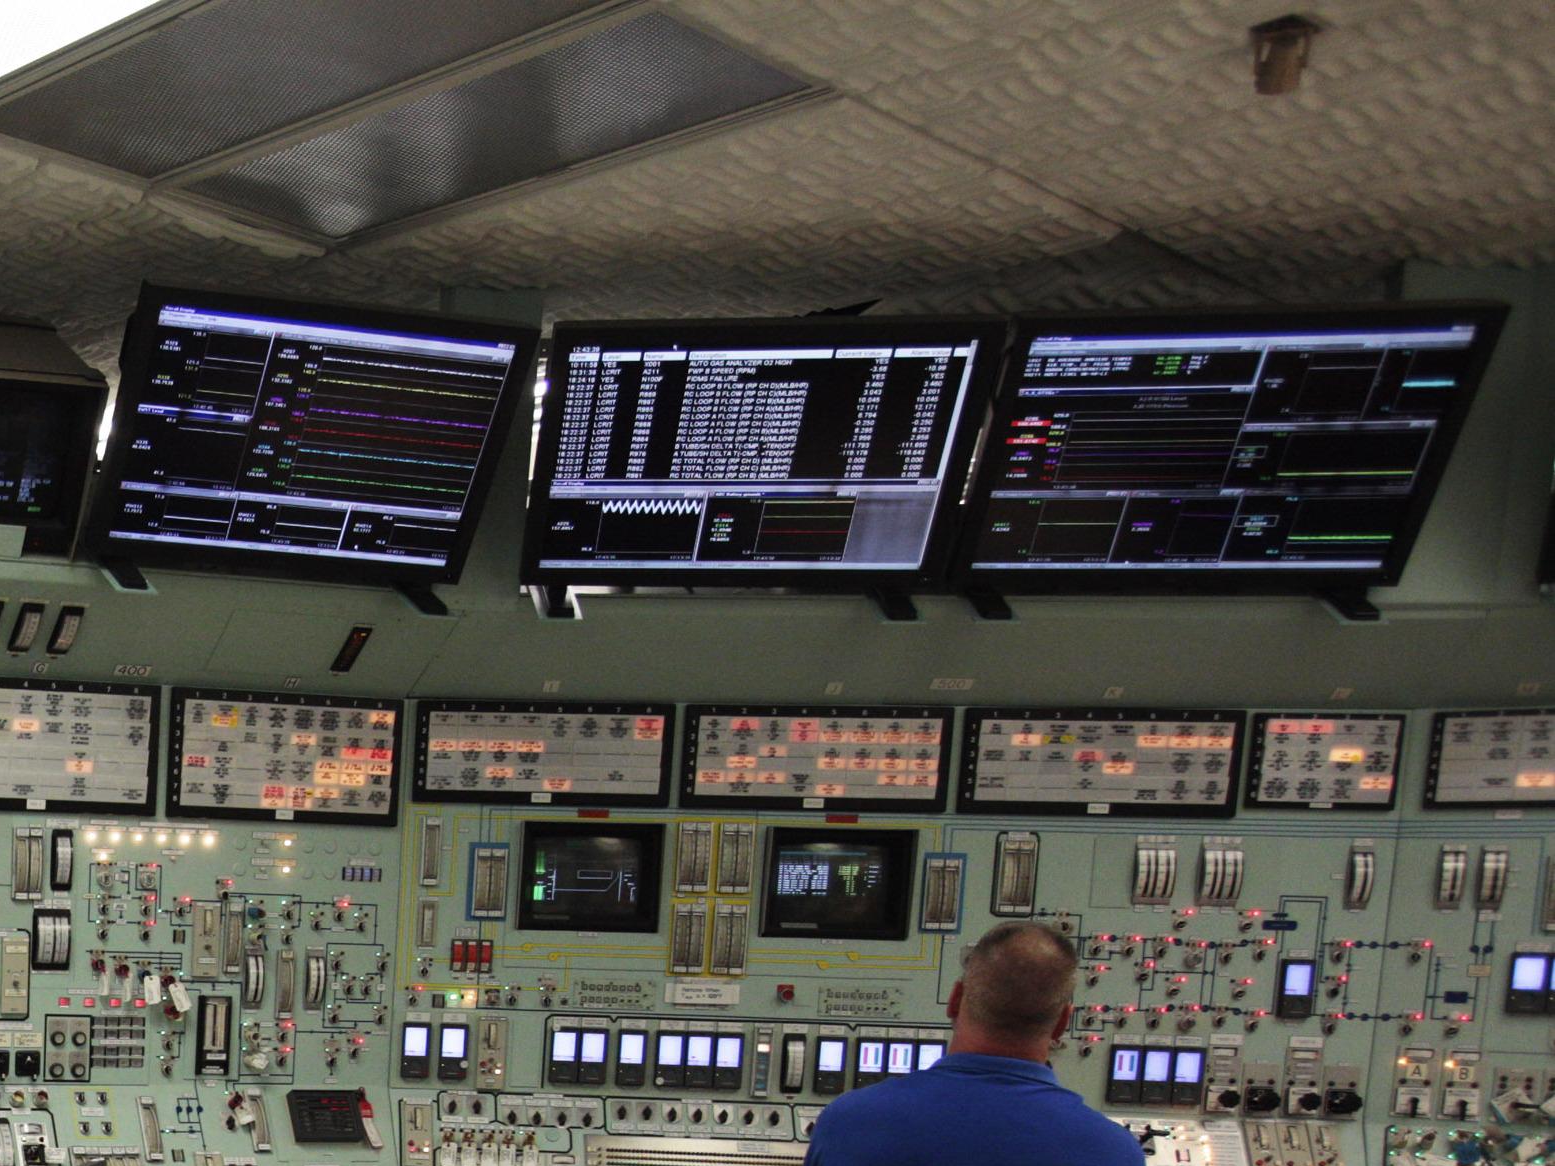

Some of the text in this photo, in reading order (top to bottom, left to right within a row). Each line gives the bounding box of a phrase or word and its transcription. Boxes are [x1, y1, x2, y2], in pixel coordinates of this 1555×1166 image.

[117, 666, 150, 675] 400
[1411, 1065, 1422, 1077] A
[1458, 1067, 1469, 1080] B
